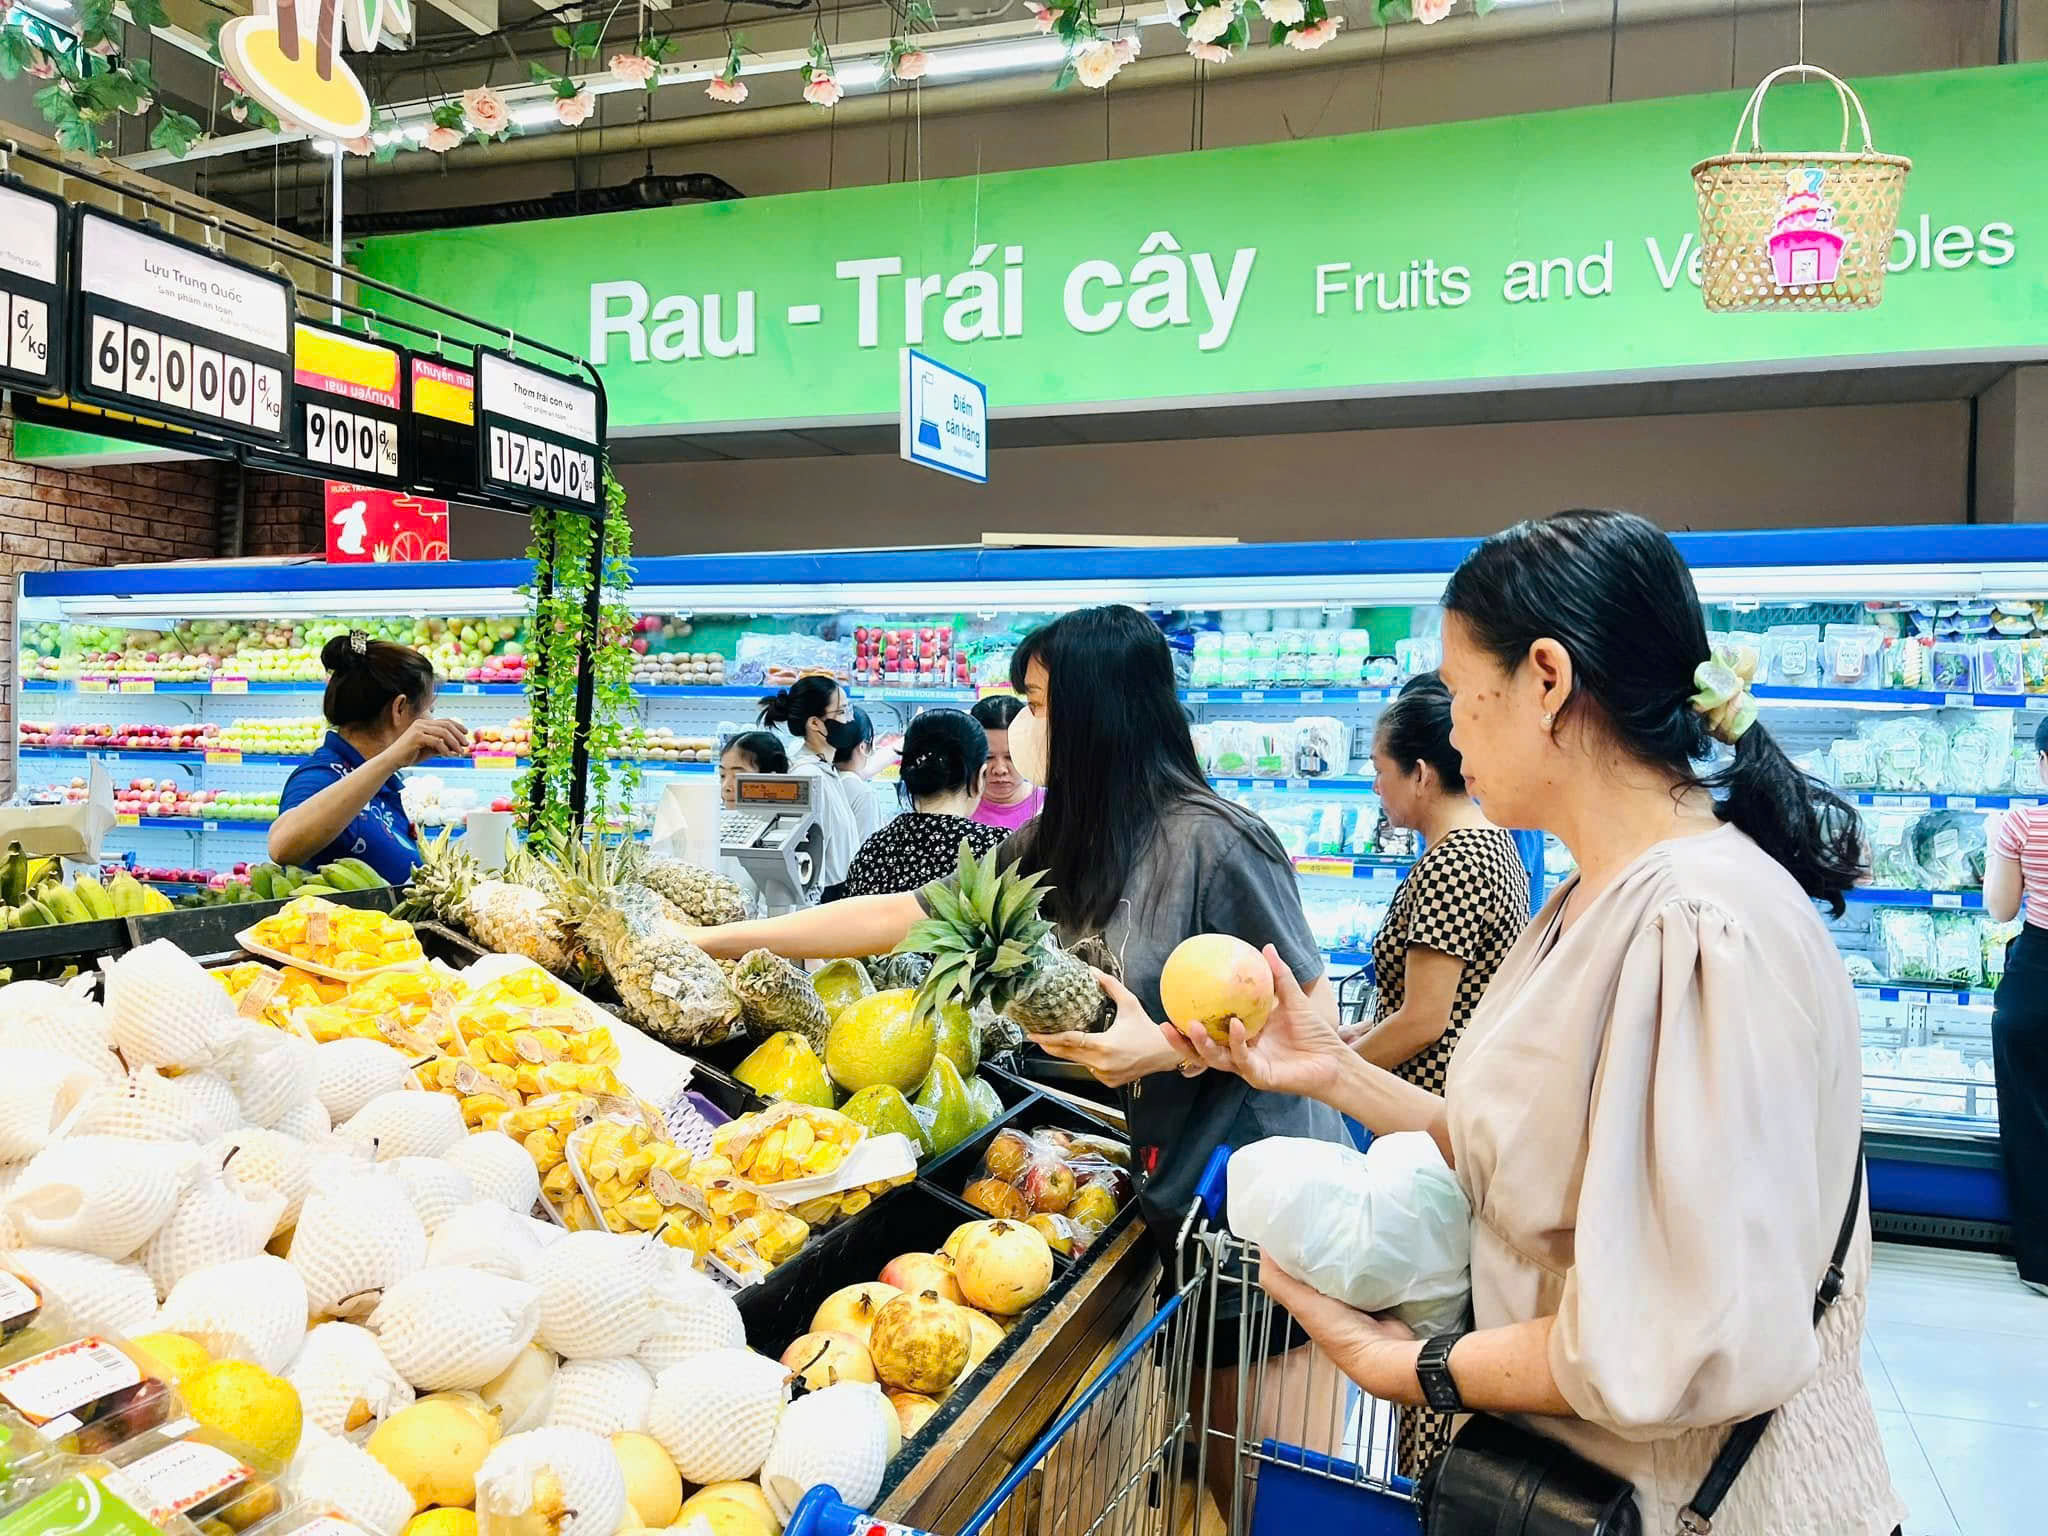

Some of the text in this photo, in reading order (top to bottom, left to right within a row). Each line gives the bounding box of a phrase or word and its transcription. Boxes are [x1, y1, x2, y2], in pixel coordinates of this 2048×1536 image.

[172, 269, 207, 293] Trung
[210, 283, 243, 303] Quốc
[589, 280, 755, 365] Rau
[835, 243, 1023, 347] Trái
[1063, 231, 1257, 351] cây
[1315, 258, 1472, 314] Fruits
[1502, 240, 1613, 303] and
[99, 330, 246, 406] 69.000
[311, 413, 373, 459] 900
[497, 436, 579, 491] 17.500
